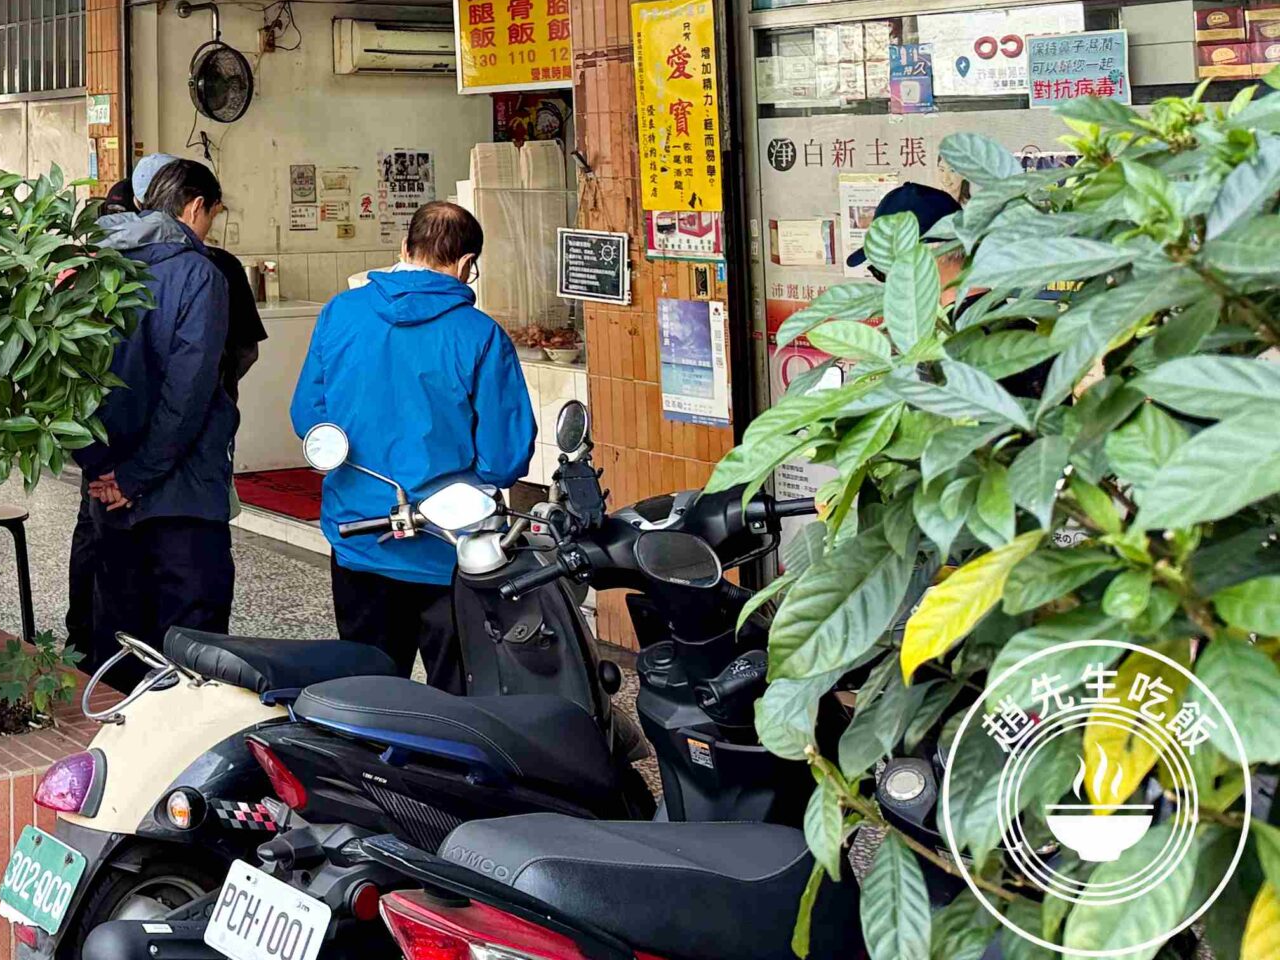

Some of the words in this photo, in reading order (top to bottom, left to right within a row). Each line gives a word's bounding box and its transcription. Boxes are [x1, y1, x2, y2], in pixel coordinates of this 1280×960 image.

[508, 49, 536, 65] 110
[550, 46, 569, 62] 12
[666, 43, 695, 138] 愛寶
[1033, 76, 1124, 100] 對抗病毒!
[768, 137, 928, 171] 淨白新主張
[214, 882, 315, 960] PCH-1001
